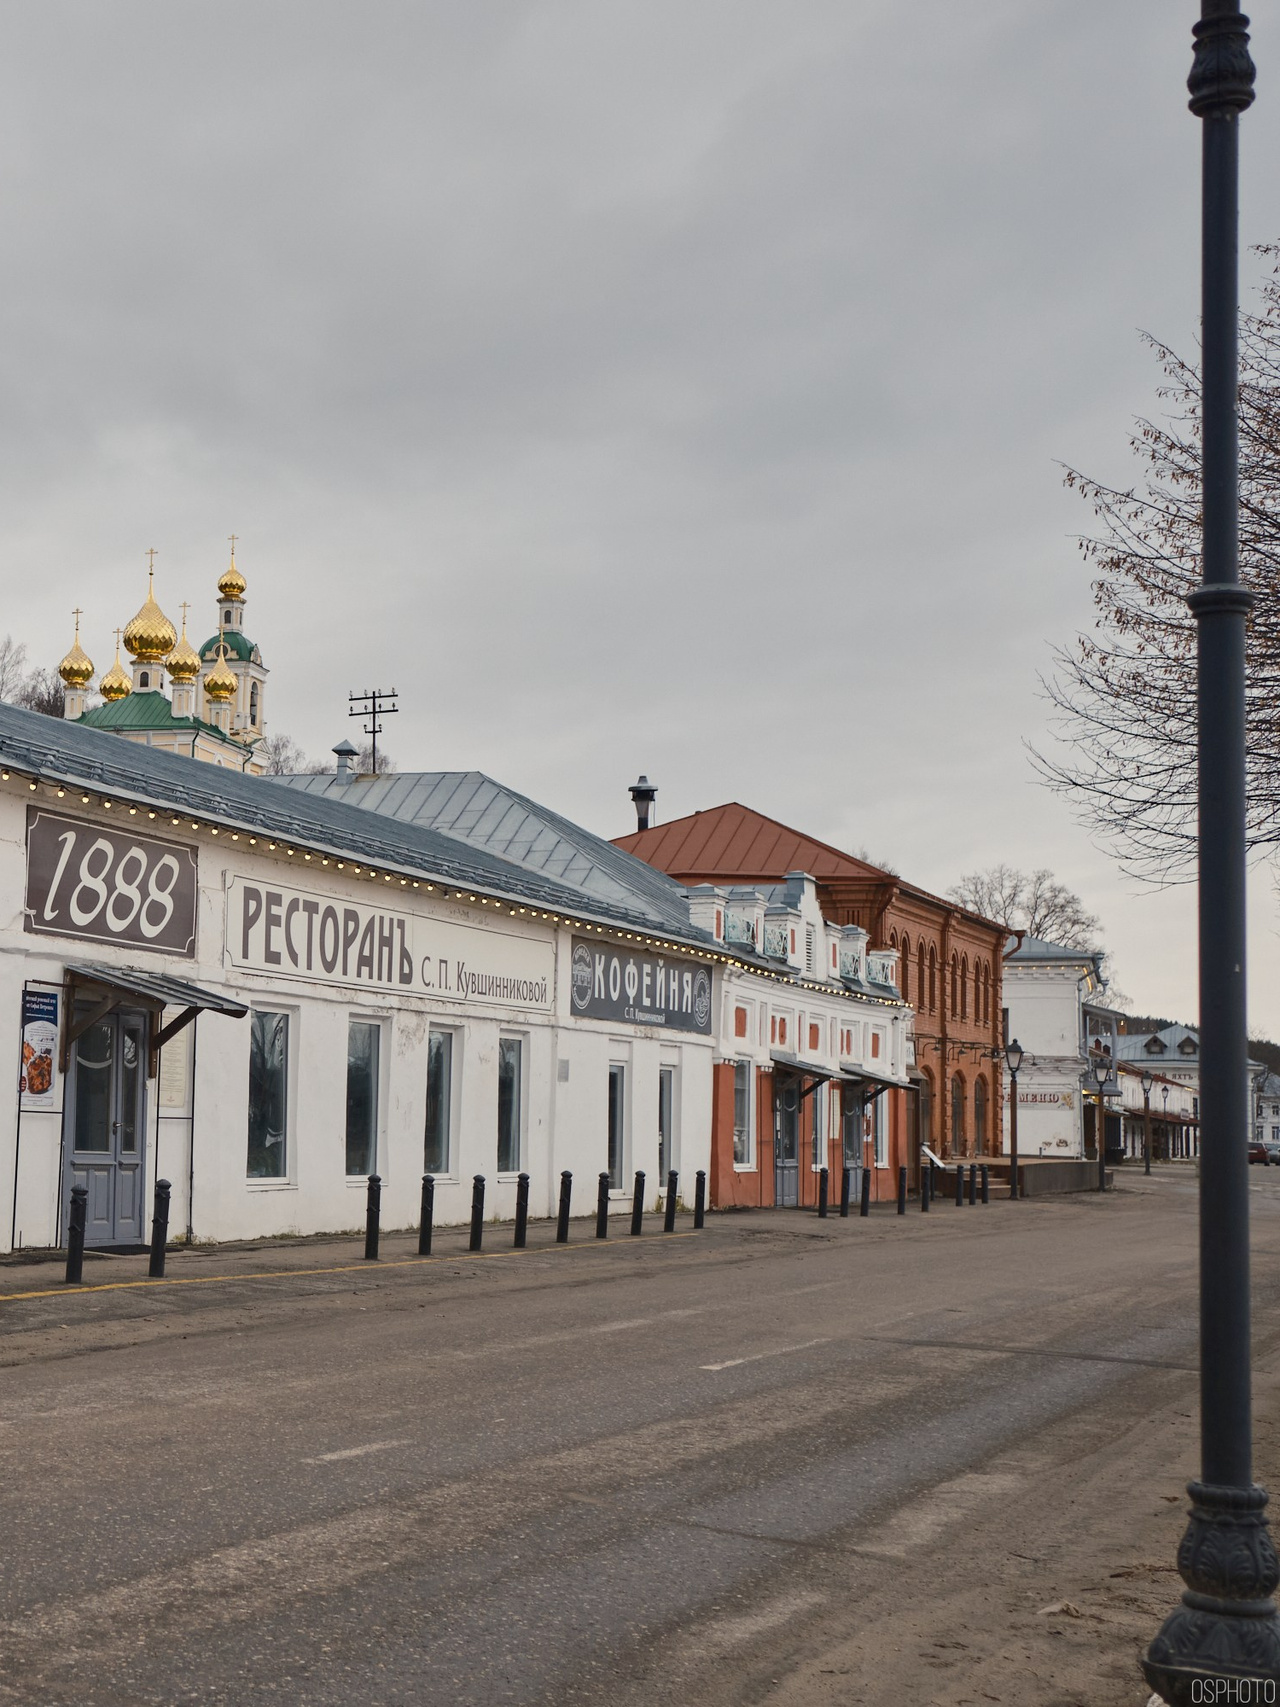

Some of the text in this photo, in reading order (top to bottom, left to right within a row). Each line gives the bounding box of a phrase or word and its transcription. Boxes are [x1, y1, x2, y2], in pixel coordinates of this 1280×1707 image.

[43, 831, 180, 938] 1888
[242, 886, 413, 985] РЕСТОРАНЪ
[457, 961, 547, 1003] Кувшинниковой
[594, 954, 692, 1013] КОФЕЙНЯ
[1018, 1093, 1060, 1104] МЕНЮ
